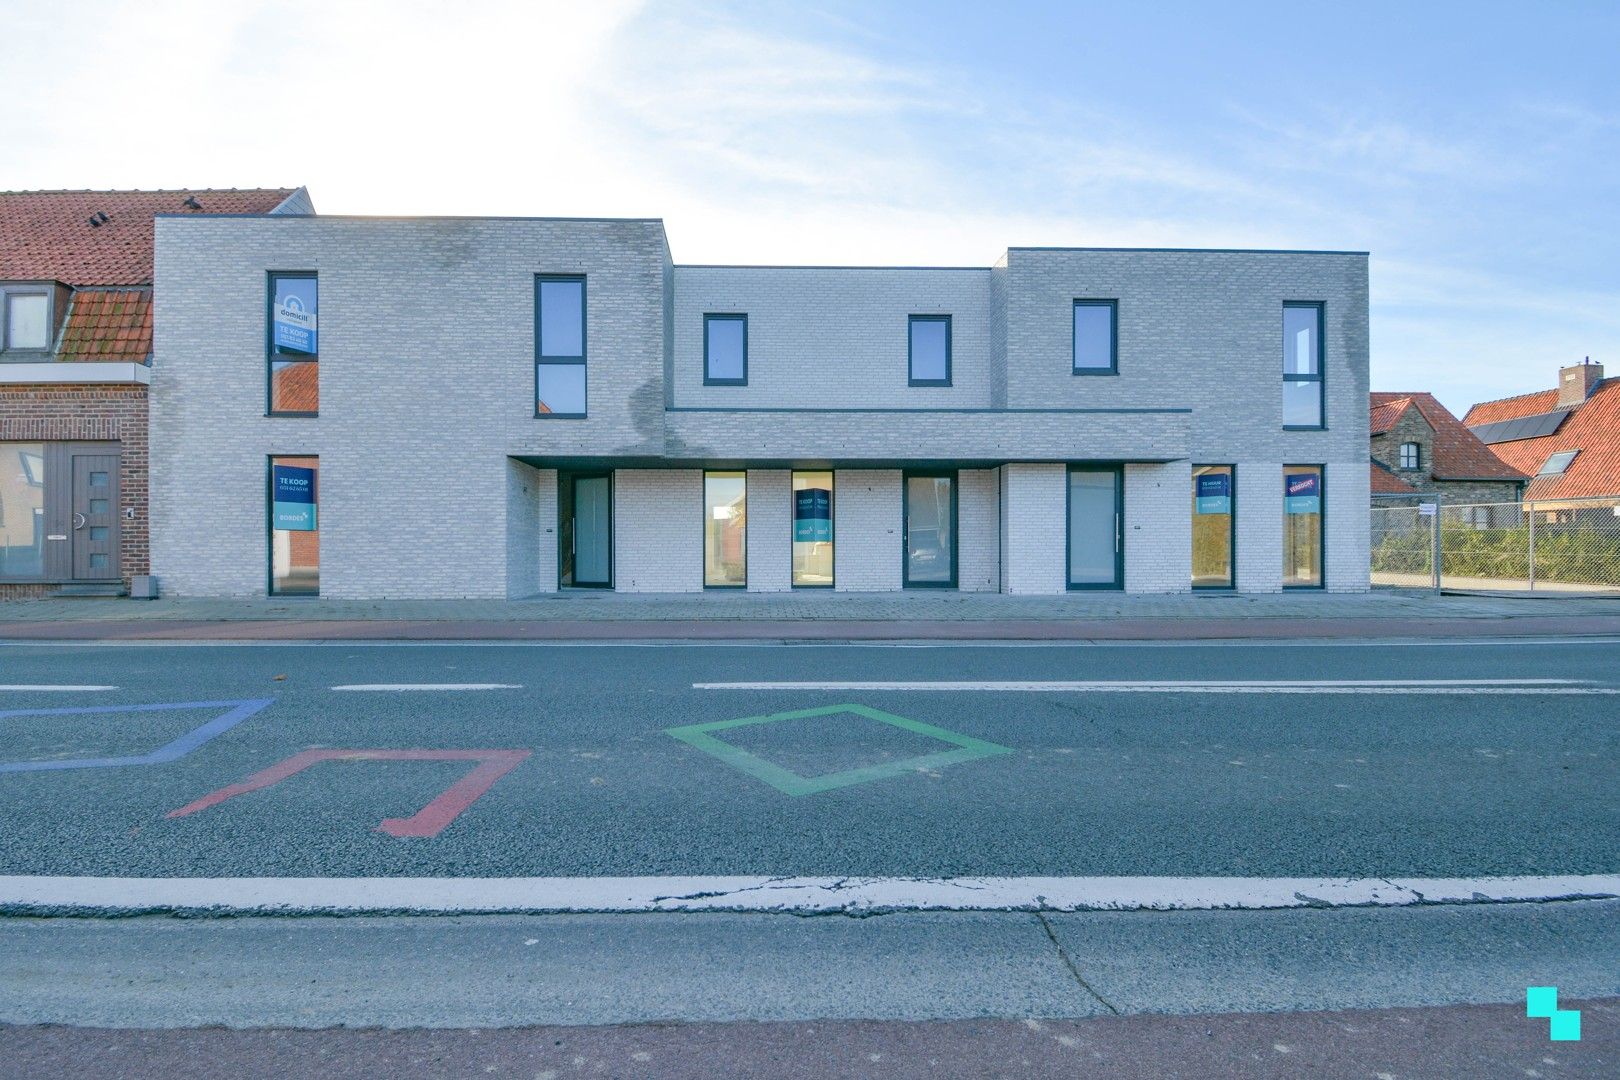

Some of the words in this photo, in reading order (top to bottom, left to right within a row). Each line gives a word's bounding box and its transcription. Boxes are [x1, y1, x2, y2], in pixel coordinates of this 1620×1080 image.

[280, 309, 308, 322] domicill
[280, 325, 289, 333] TE
[289, 327, 309, 338] KOOP
